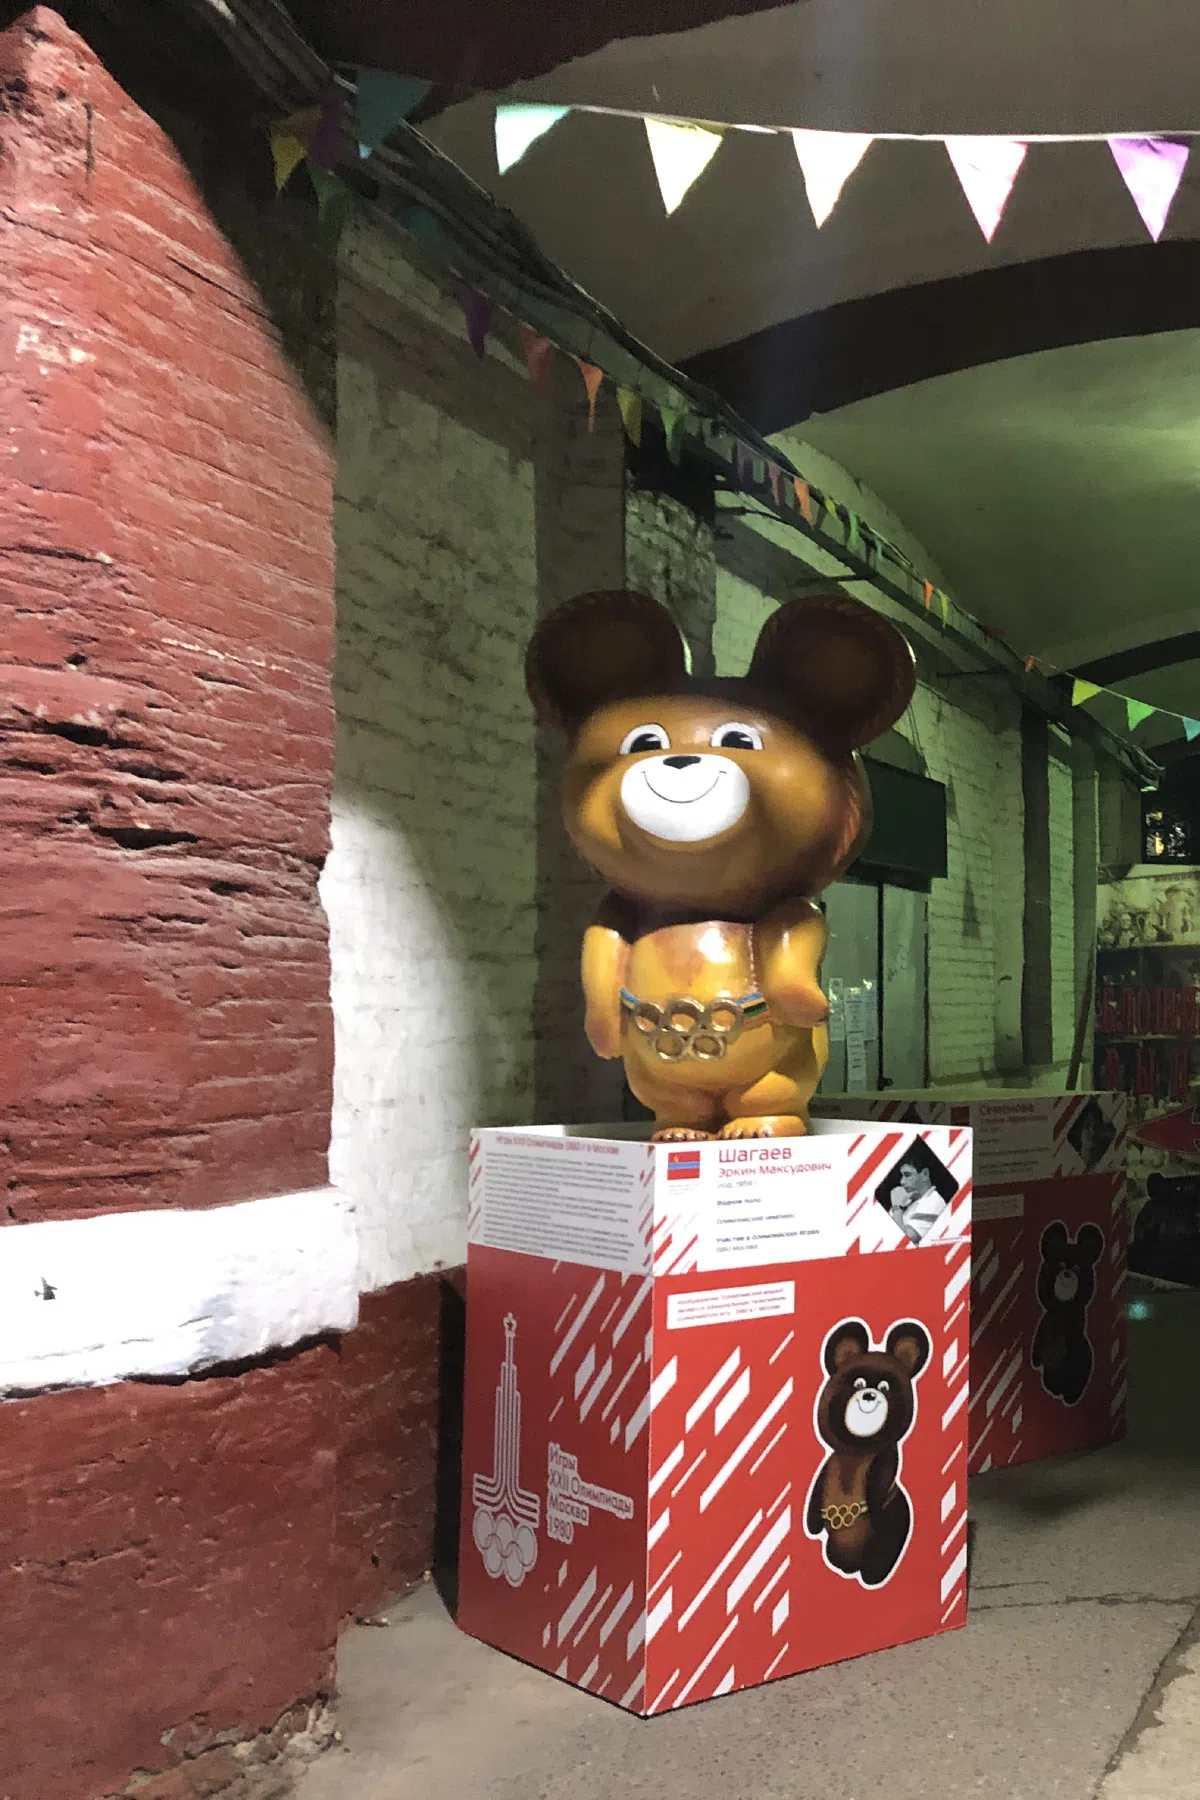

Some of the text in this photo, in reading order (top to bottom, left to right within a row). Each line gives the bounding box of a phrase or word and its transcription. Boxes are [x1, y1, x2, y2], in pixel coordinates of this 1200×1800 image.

[718, 1147, 792, 1163] Шагаев
[718, 1162, 832, 1178] Эркин Максудович
[549, 1445, 576, 1474] Игры
[549, 1468, 632, 1515] XXII Олимпиады
[549, 1493, 588, 1522] Москва
[549, 1514, 572, 1541] 1980
